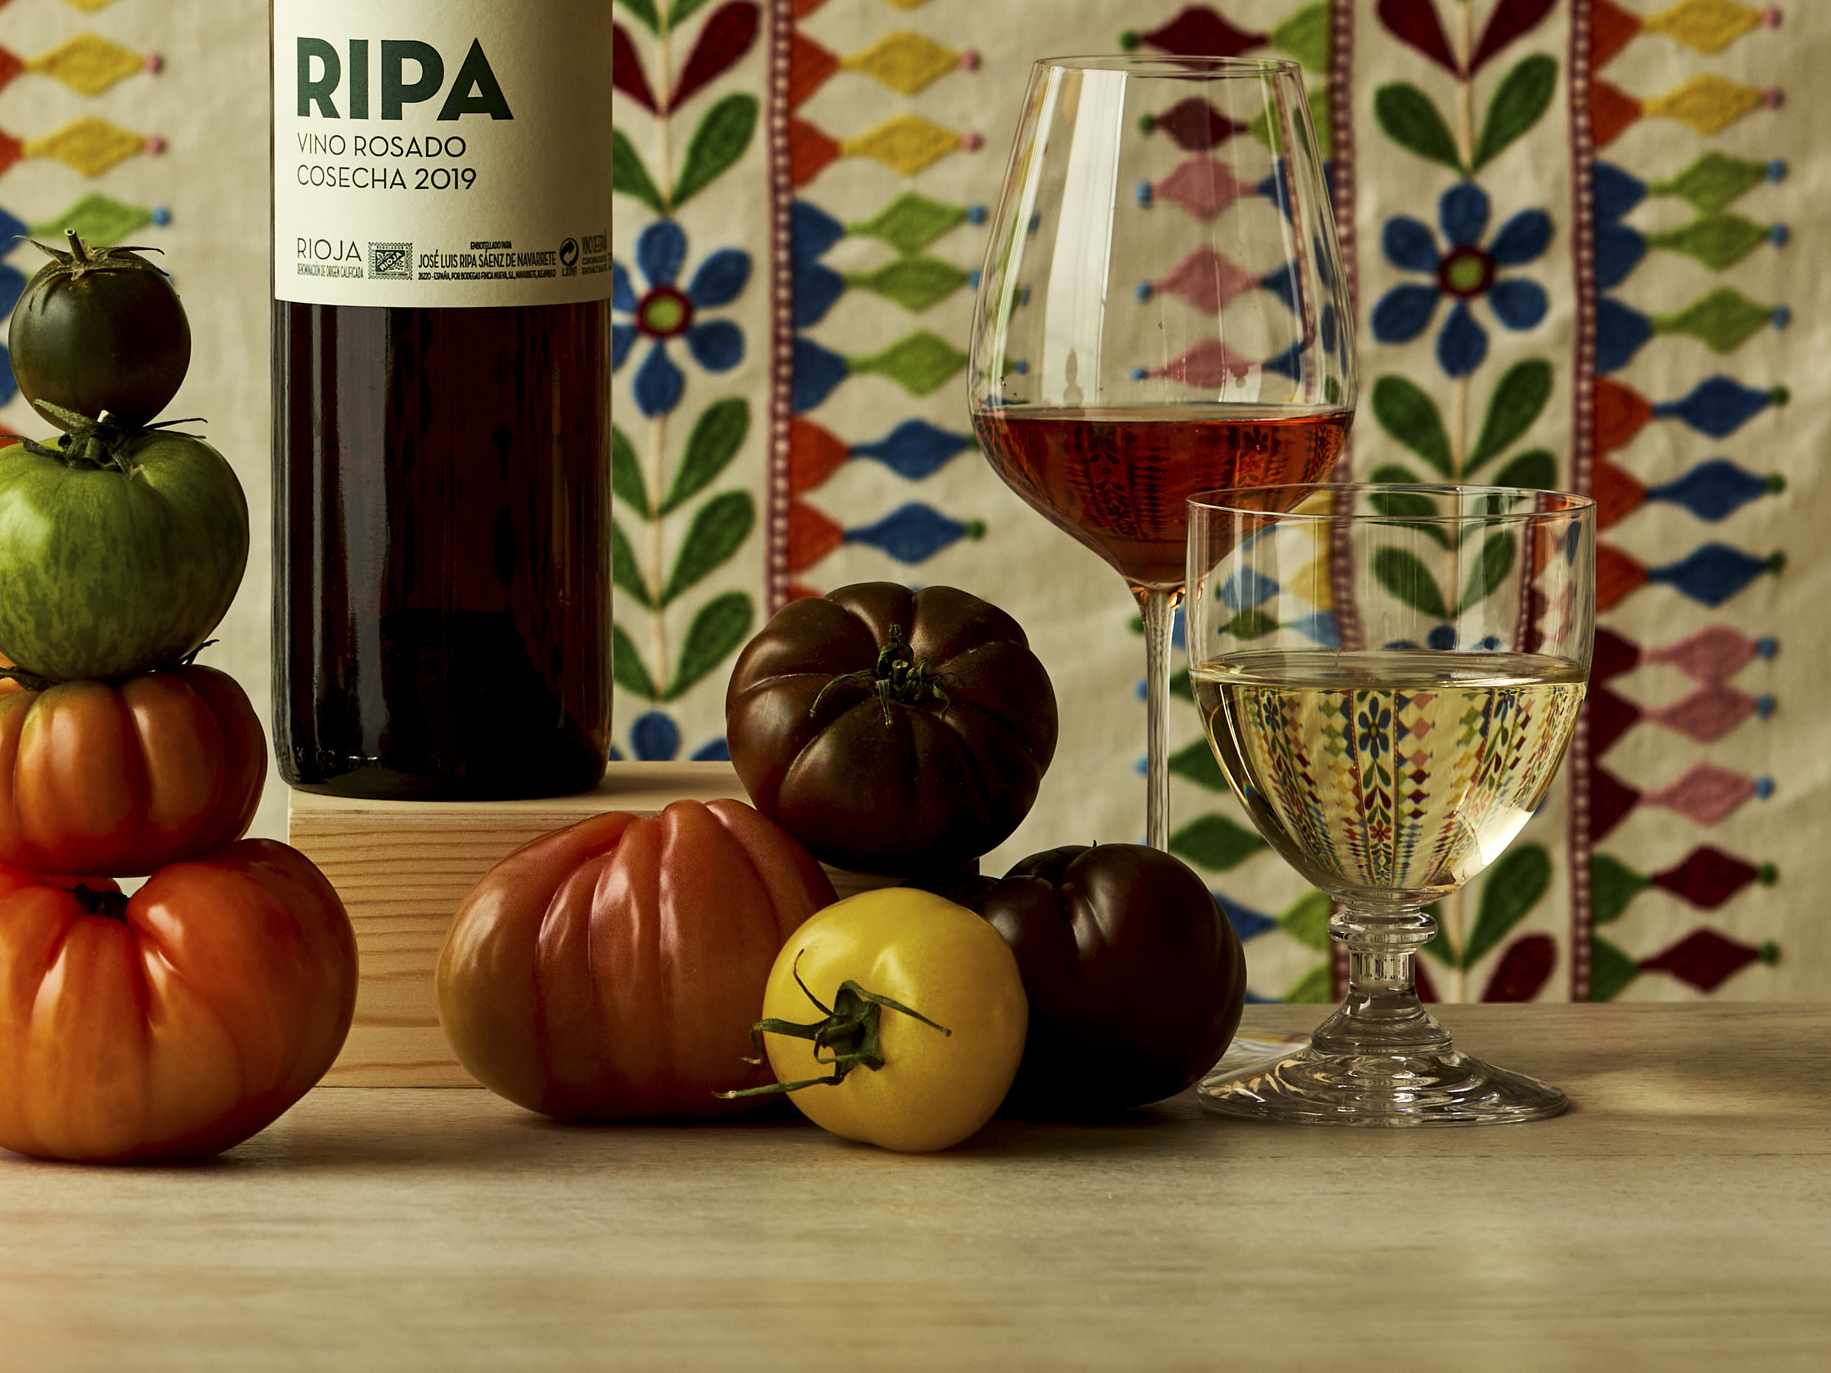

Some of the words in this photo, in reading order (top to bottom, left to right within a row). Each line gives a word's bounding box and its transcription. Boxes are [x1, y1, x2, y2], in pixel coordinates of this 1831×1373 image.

[296, 36, 514, 121] RIPA
[297, 132, 346, 156] VINO
[354, 136, 467, 158] ROSADO
[297, 164, 407, 190] COSECHA
[414, 168, 477, 190] 2019
[297, 237, 362, 262] RIOJA
[379, 252, 402, 271] RIOJA
[418, 249, 439, 268] JOSÉ
[440, 254, 458, 268] LUIS
[459, 254, 477, 268] RIPA
[478, 249, 504, 268] SÁENZ
[505, 253, 516, 268] DE
[517, 251, 557, 267] NAVARRETE
